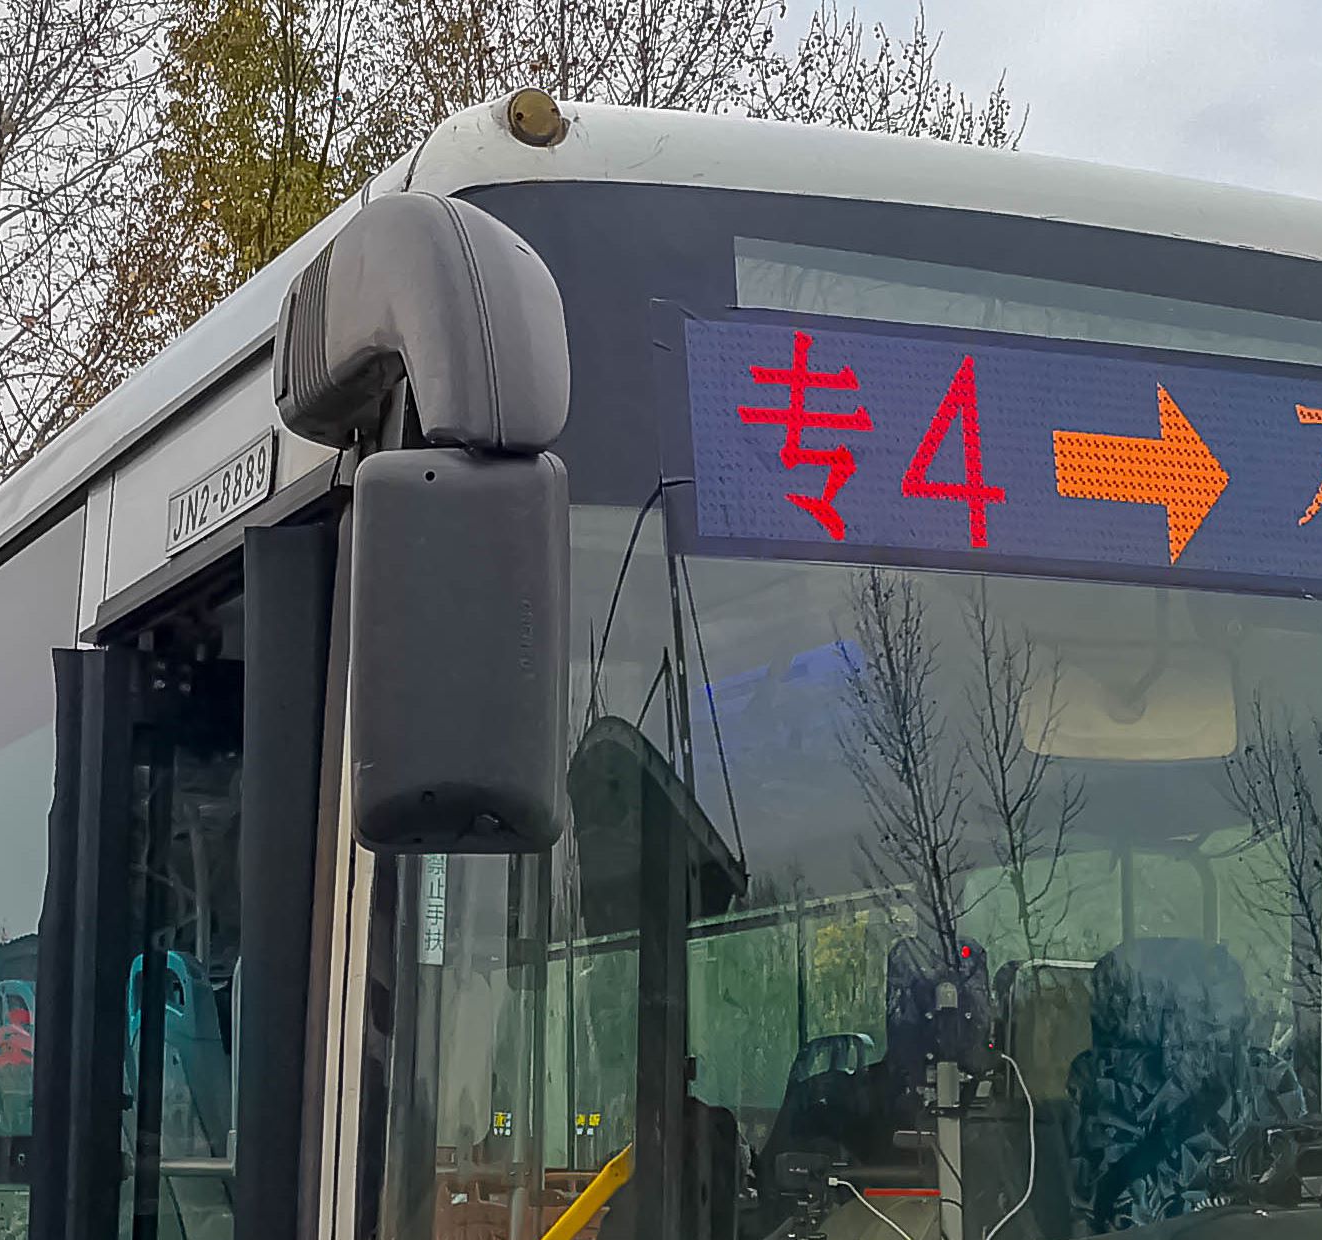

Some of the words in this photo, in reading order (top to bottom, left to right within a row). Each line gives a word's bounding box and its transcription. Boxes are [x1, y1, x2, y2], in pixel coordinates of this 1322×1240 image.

[737, 330, 1006, 549] 专4
[173, 446, 267, 541] JN2-8889
[425, 855, 445, 951] 禁止手扶
